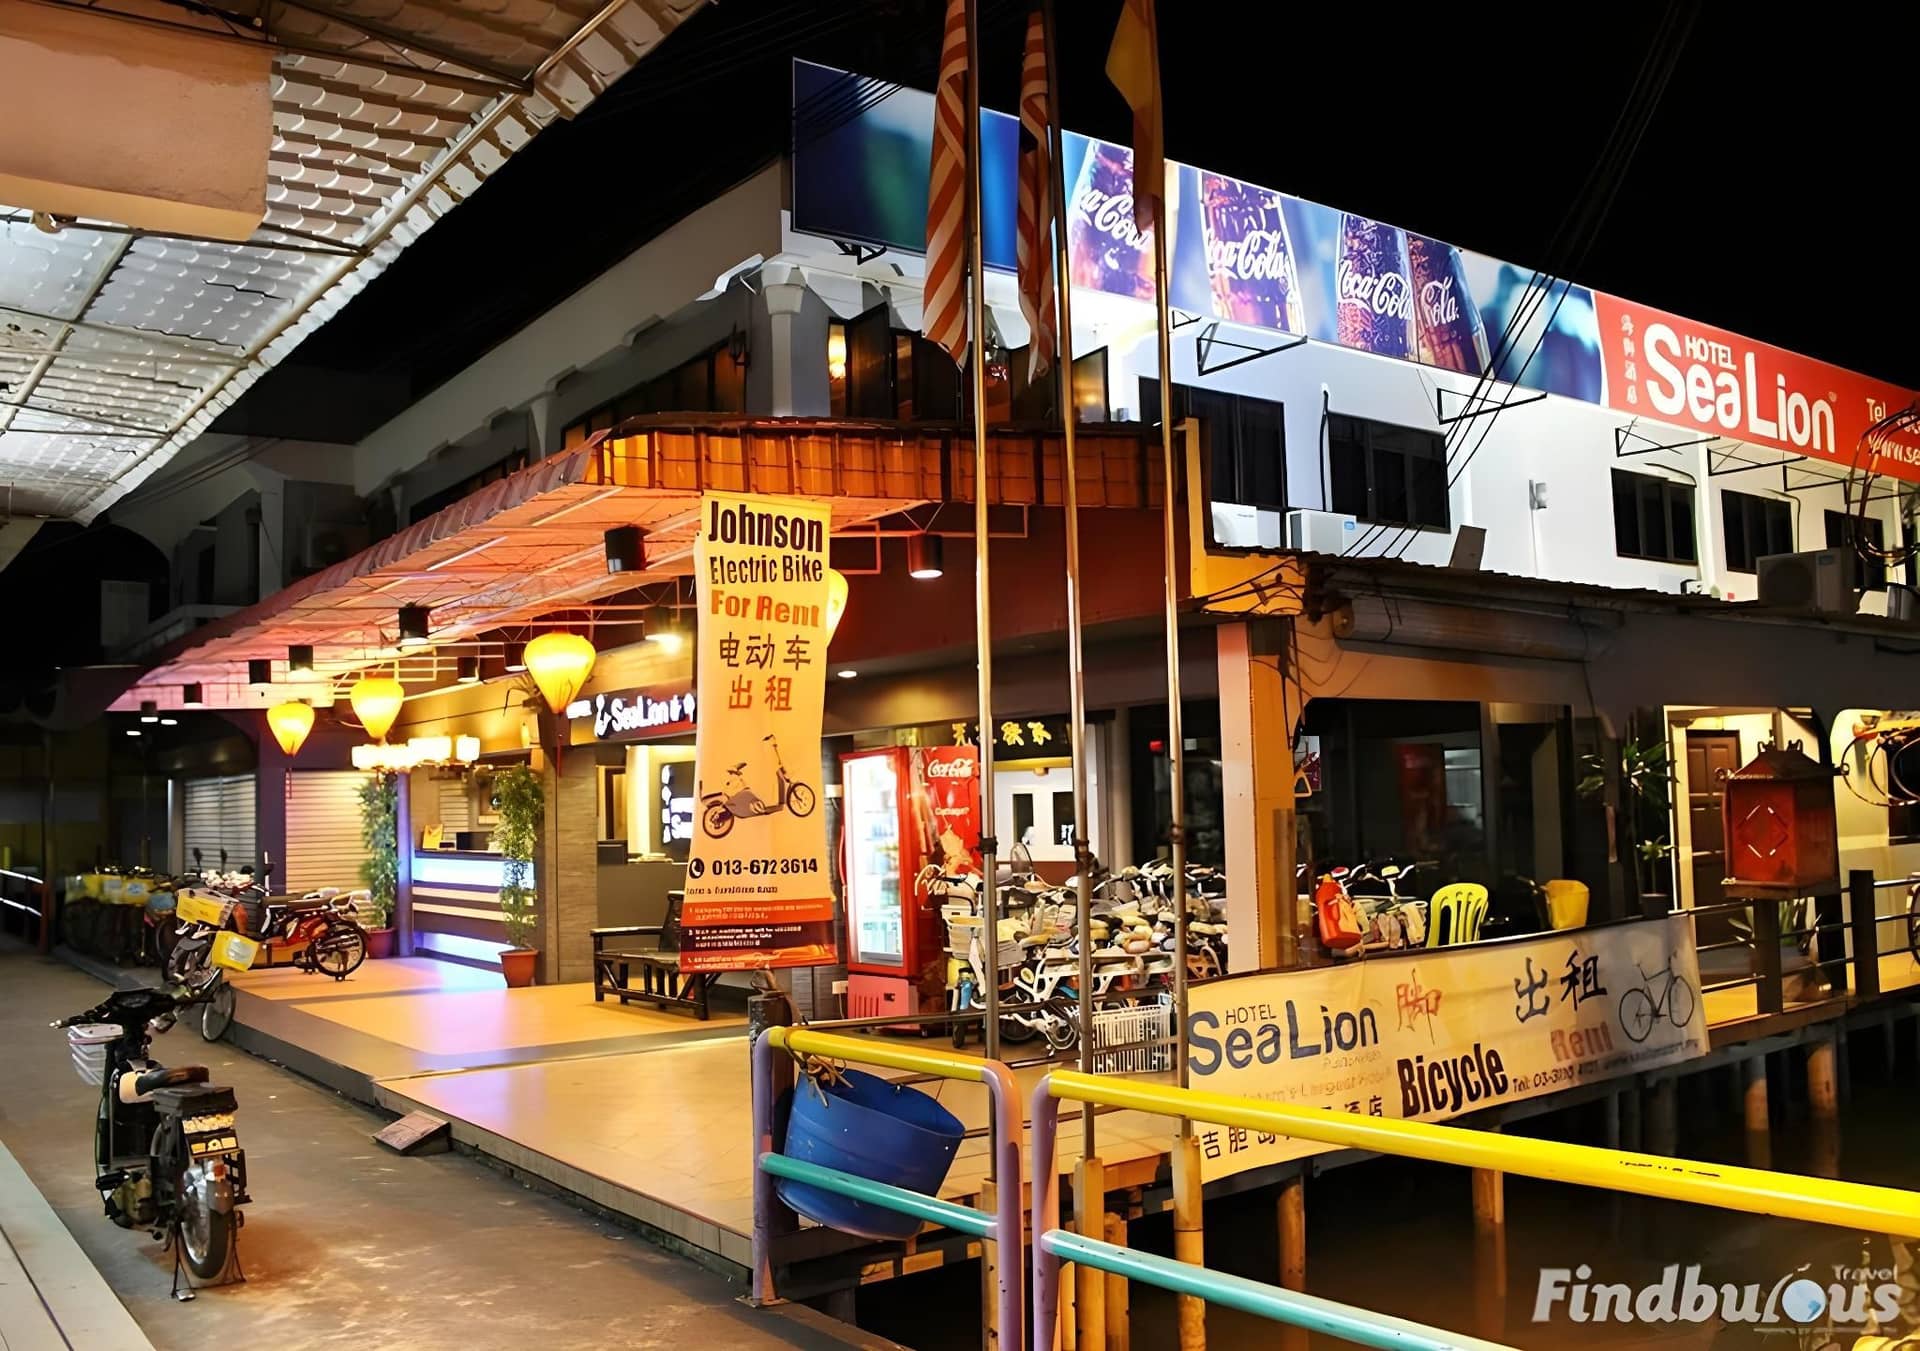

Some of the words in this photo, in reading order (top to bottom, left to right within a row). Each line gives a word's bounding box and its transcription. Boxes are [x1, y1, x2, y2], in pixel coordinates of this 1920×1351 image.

[1684, 334, 1737, 371] HOTEL
[708, 500, 823, 553] Johnson
[709, 554, 778, 585] Electric
[782, 554, 823, 583] Bike
[711, 589, 752, 618] For
[755, 595, 820, 627] Rent
[719, 631, 811, 671] 电动车
[728, 674, 793, 711] 出租
[712, 857, 777, 876] 013-672
[780, 857, 818, 875] 3614
[1225, 1003, 1278, 1025] HOTEL
[1397, 1042, 1509, 1119] Bicycle
